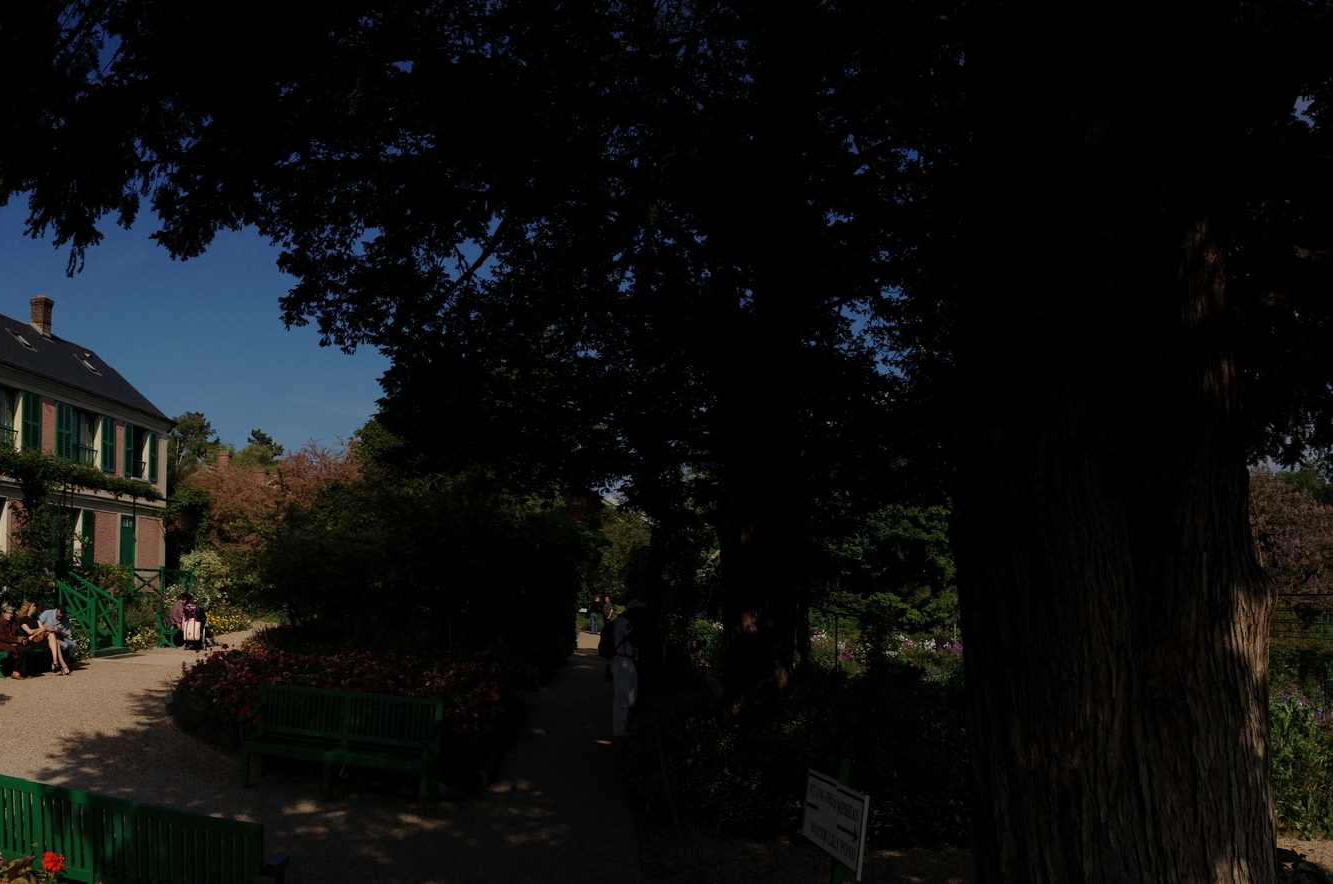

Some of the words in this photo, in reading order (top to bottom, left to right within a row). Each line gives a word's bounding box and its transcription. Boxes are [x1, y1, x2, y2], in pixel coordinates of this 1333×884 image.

[810, 783, 826, 802] ETANG
[811, 821, 827, 843] WATER
[827, 832, 840, 850] LILY
[840, 840, 856, 861] POND
